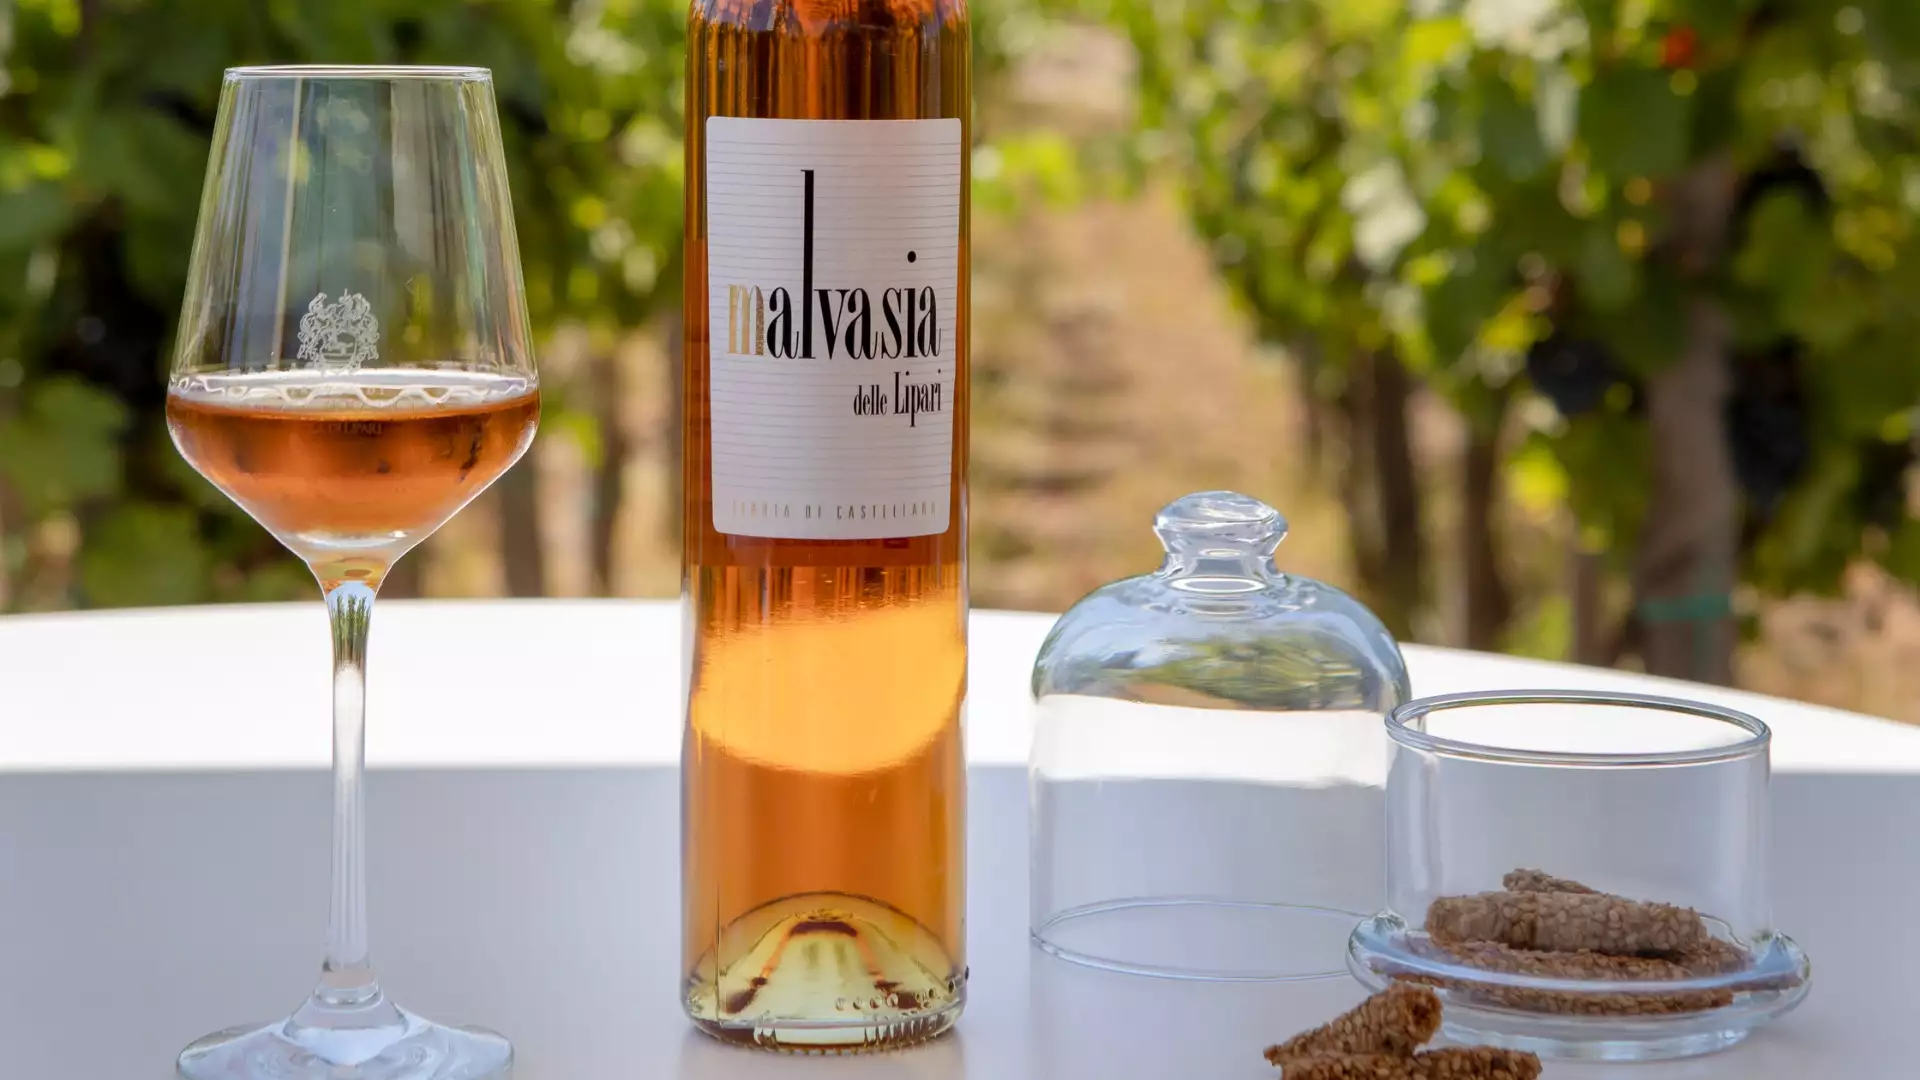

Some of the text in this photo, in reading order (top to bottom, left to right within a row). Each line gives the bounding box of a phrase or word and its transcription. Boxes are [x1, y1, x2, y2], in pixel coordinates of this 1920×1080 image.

[726, 169, 942, 360] malvasia
[853, 368, 942, 428] delle Lipari
[805, 504, 822, 519] DI
